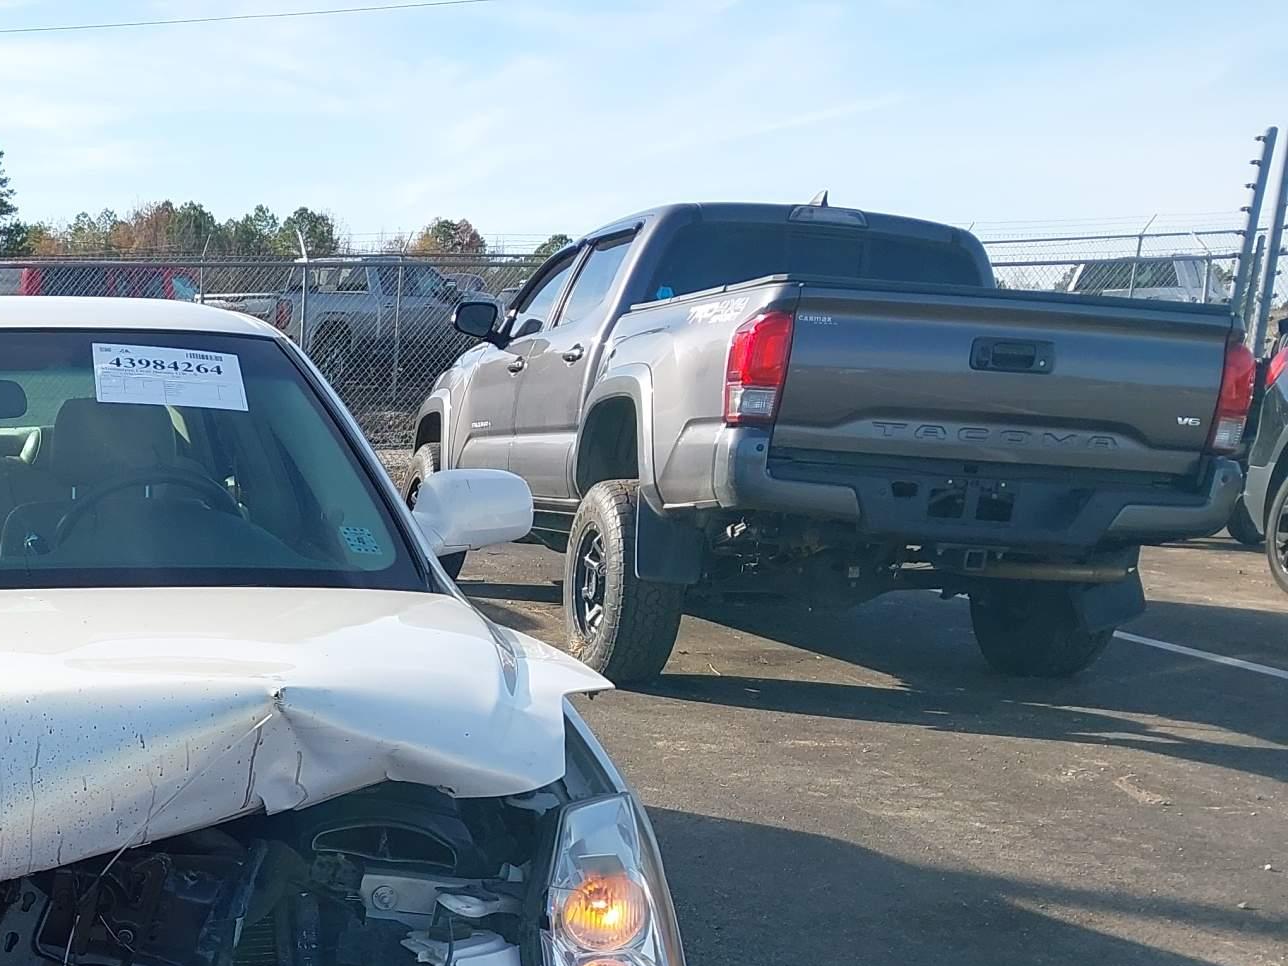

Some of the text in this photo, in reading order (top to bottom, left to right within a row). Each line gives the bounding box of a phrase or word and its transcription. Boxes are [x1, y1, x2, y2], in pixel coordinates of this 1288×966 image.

[109, 357, 223, 375] 43984264
[1177, 416, 1201, 426] V6
[871, 421, 1119, 448] TACOMA
